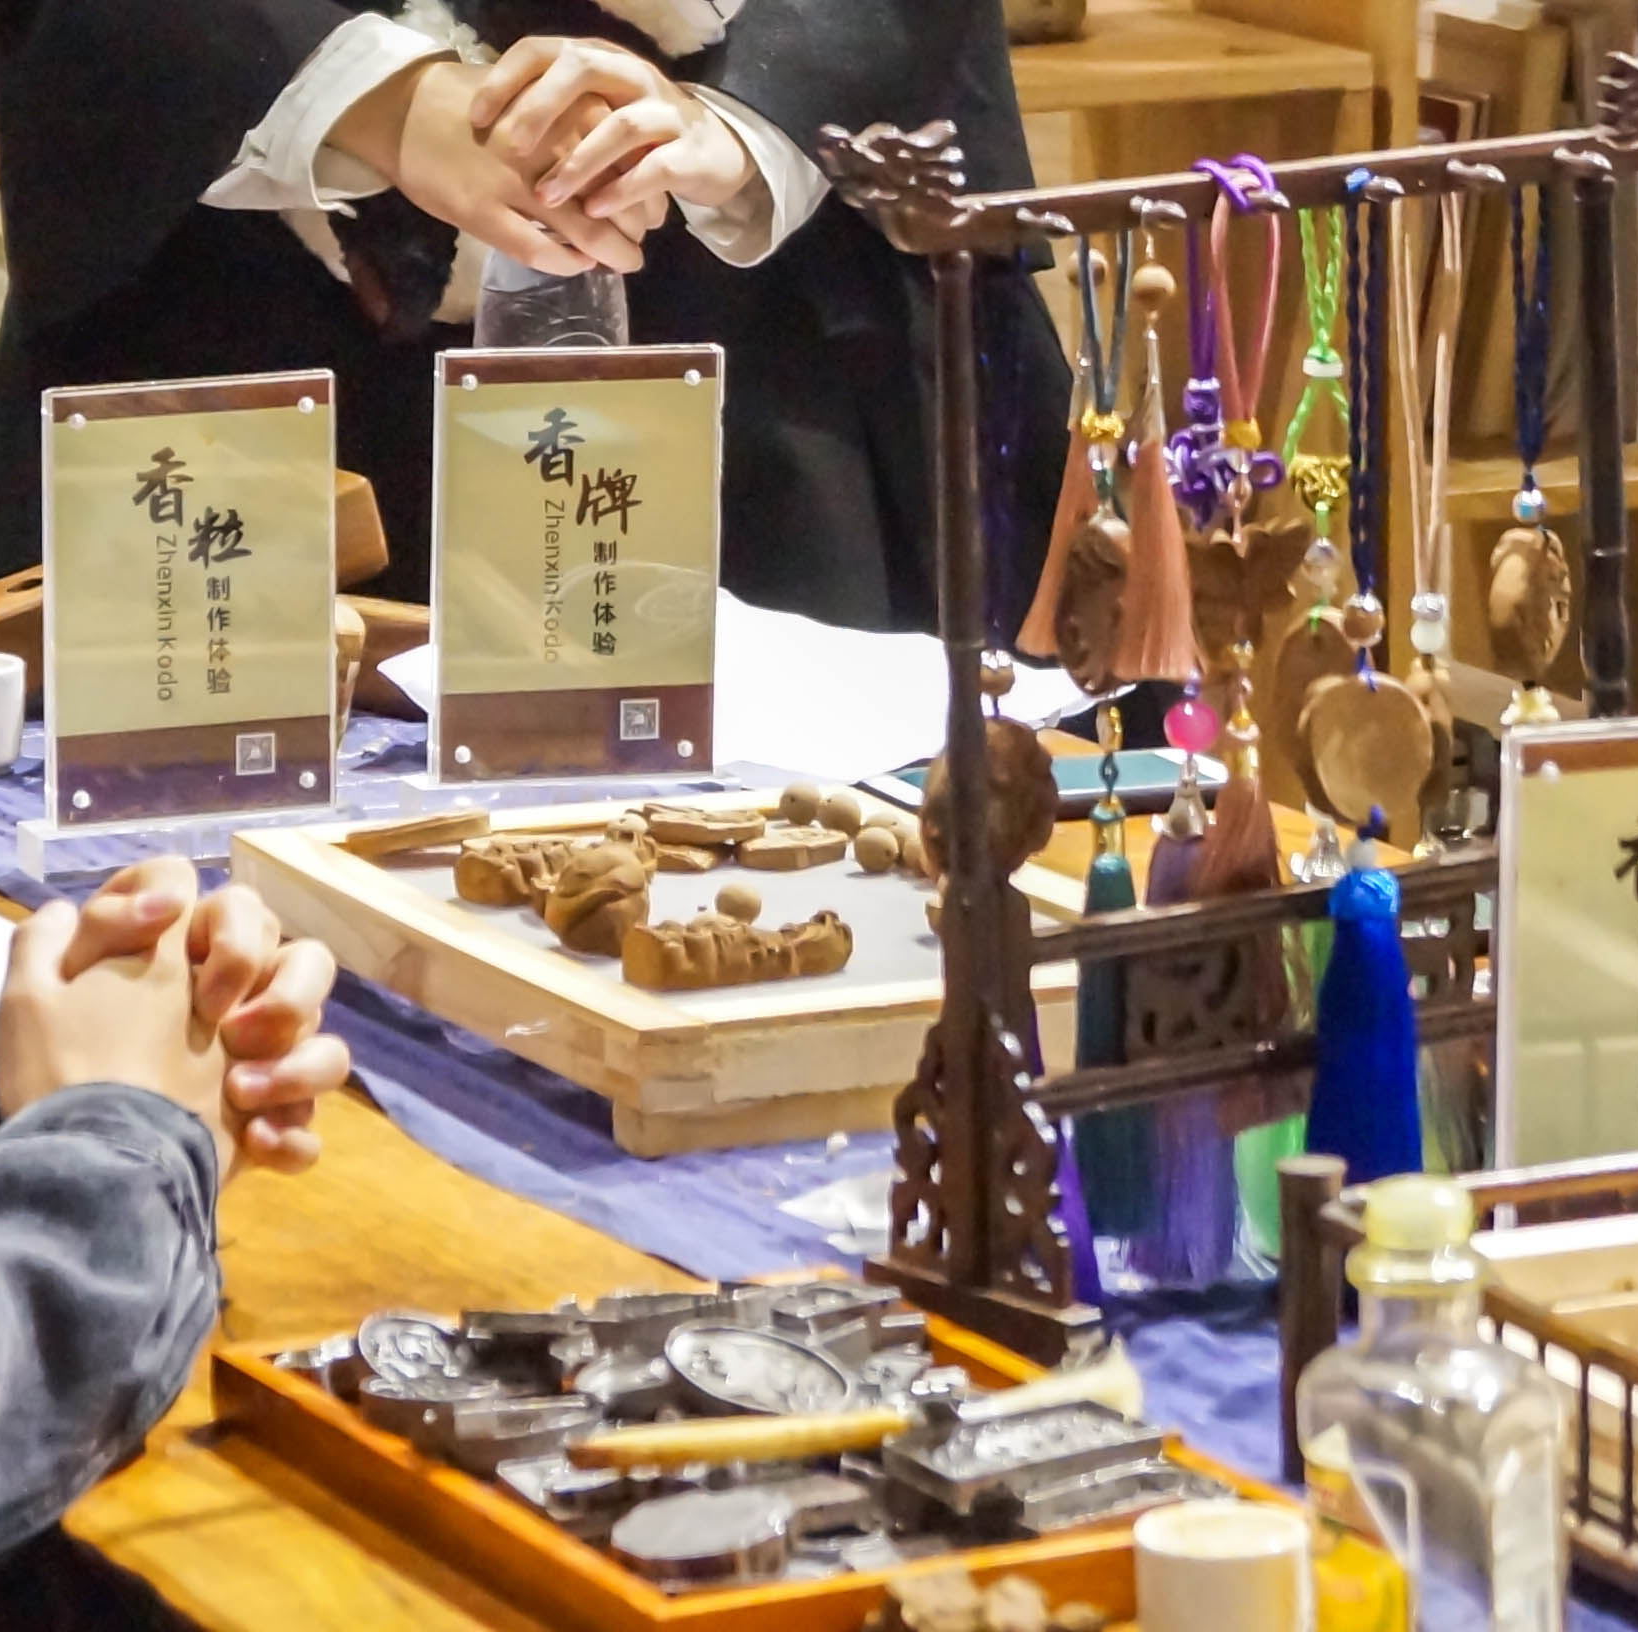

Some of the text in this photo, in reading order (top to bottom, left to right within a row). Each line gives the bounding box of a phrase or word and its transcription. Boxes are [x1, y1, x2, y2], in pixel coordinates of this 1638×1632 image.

[132, 446, 252, 569] 香粒
[524, 407, 643, 535] 香牌
[156, 533, 178, 702] Zhenxin Kodo
[206, 575, 232, 695] 制作体验
[543, 499, 565, 664] Zhenxin Kodo
[592, 540, 617, 657] 制作体验
